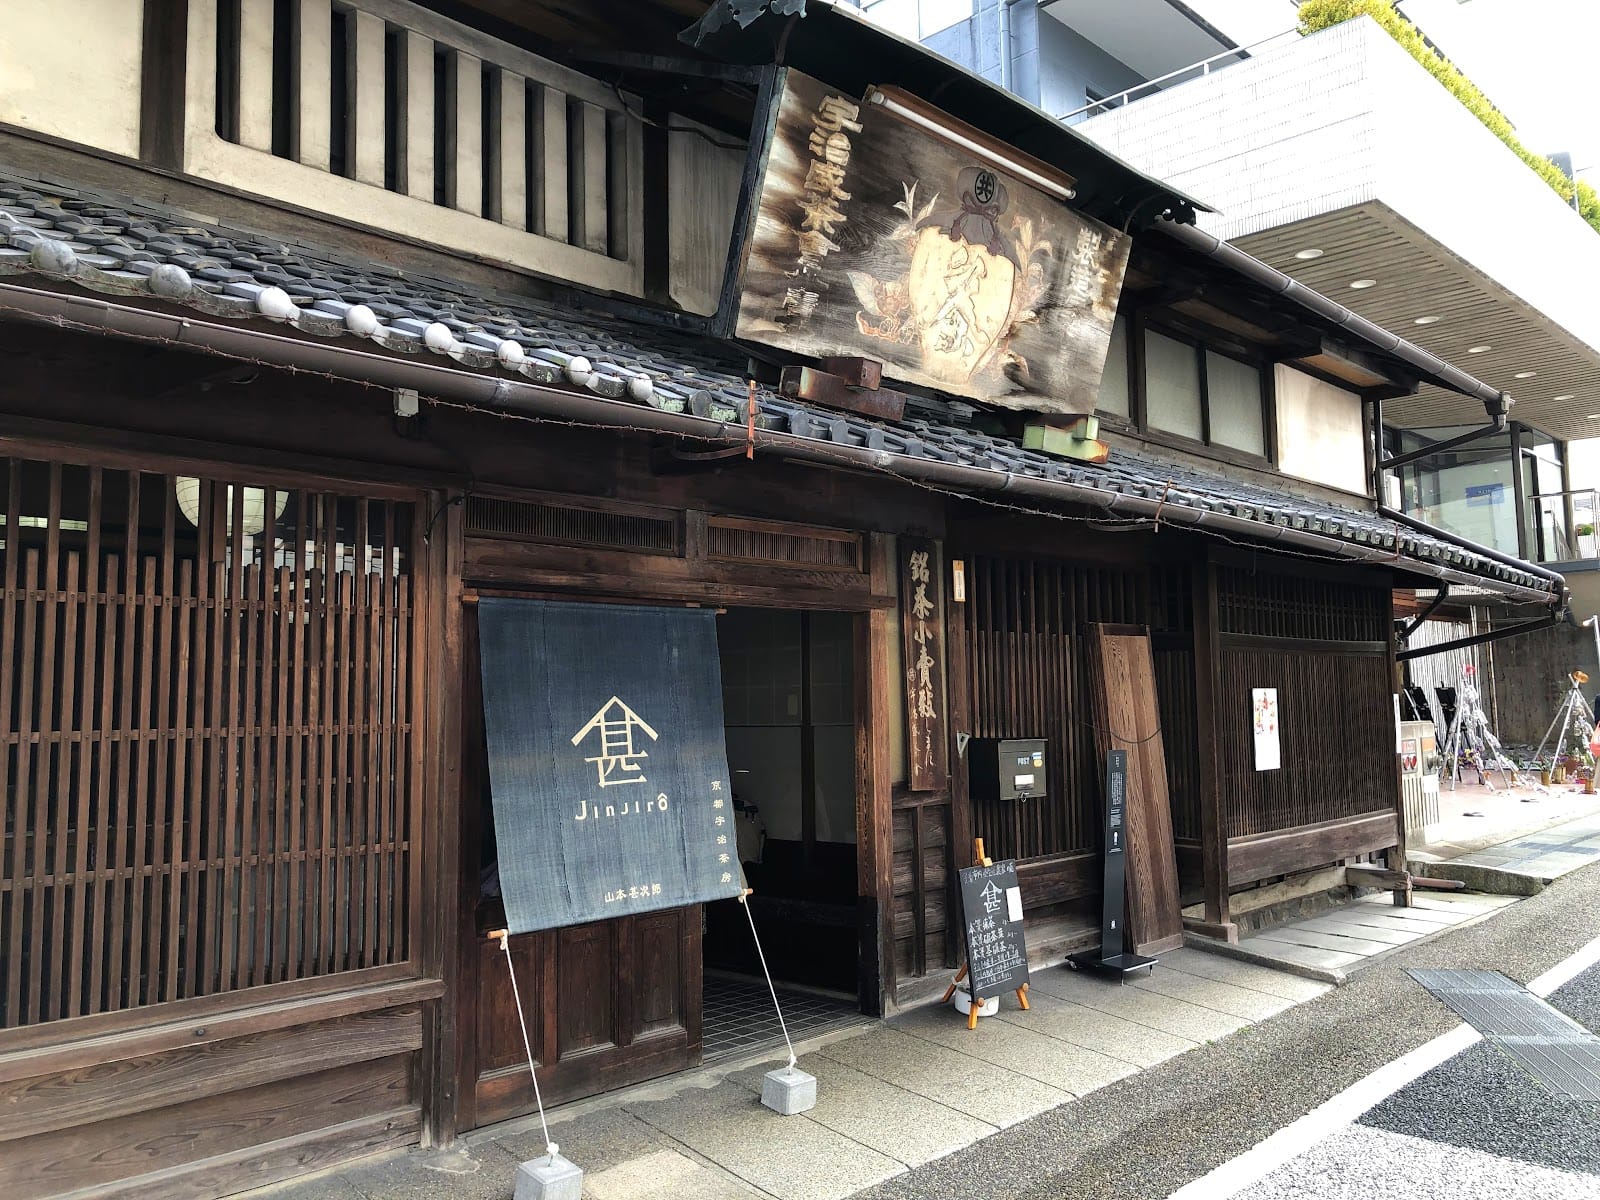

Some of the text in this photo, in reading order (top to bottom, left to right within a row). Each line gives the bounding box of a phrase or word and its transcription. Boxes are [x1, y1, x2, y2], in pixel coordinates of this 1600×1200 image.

[710, 780, 733, 883] 京都宇治茶房
[604, 883, 662, 903] 山本甚次郎
